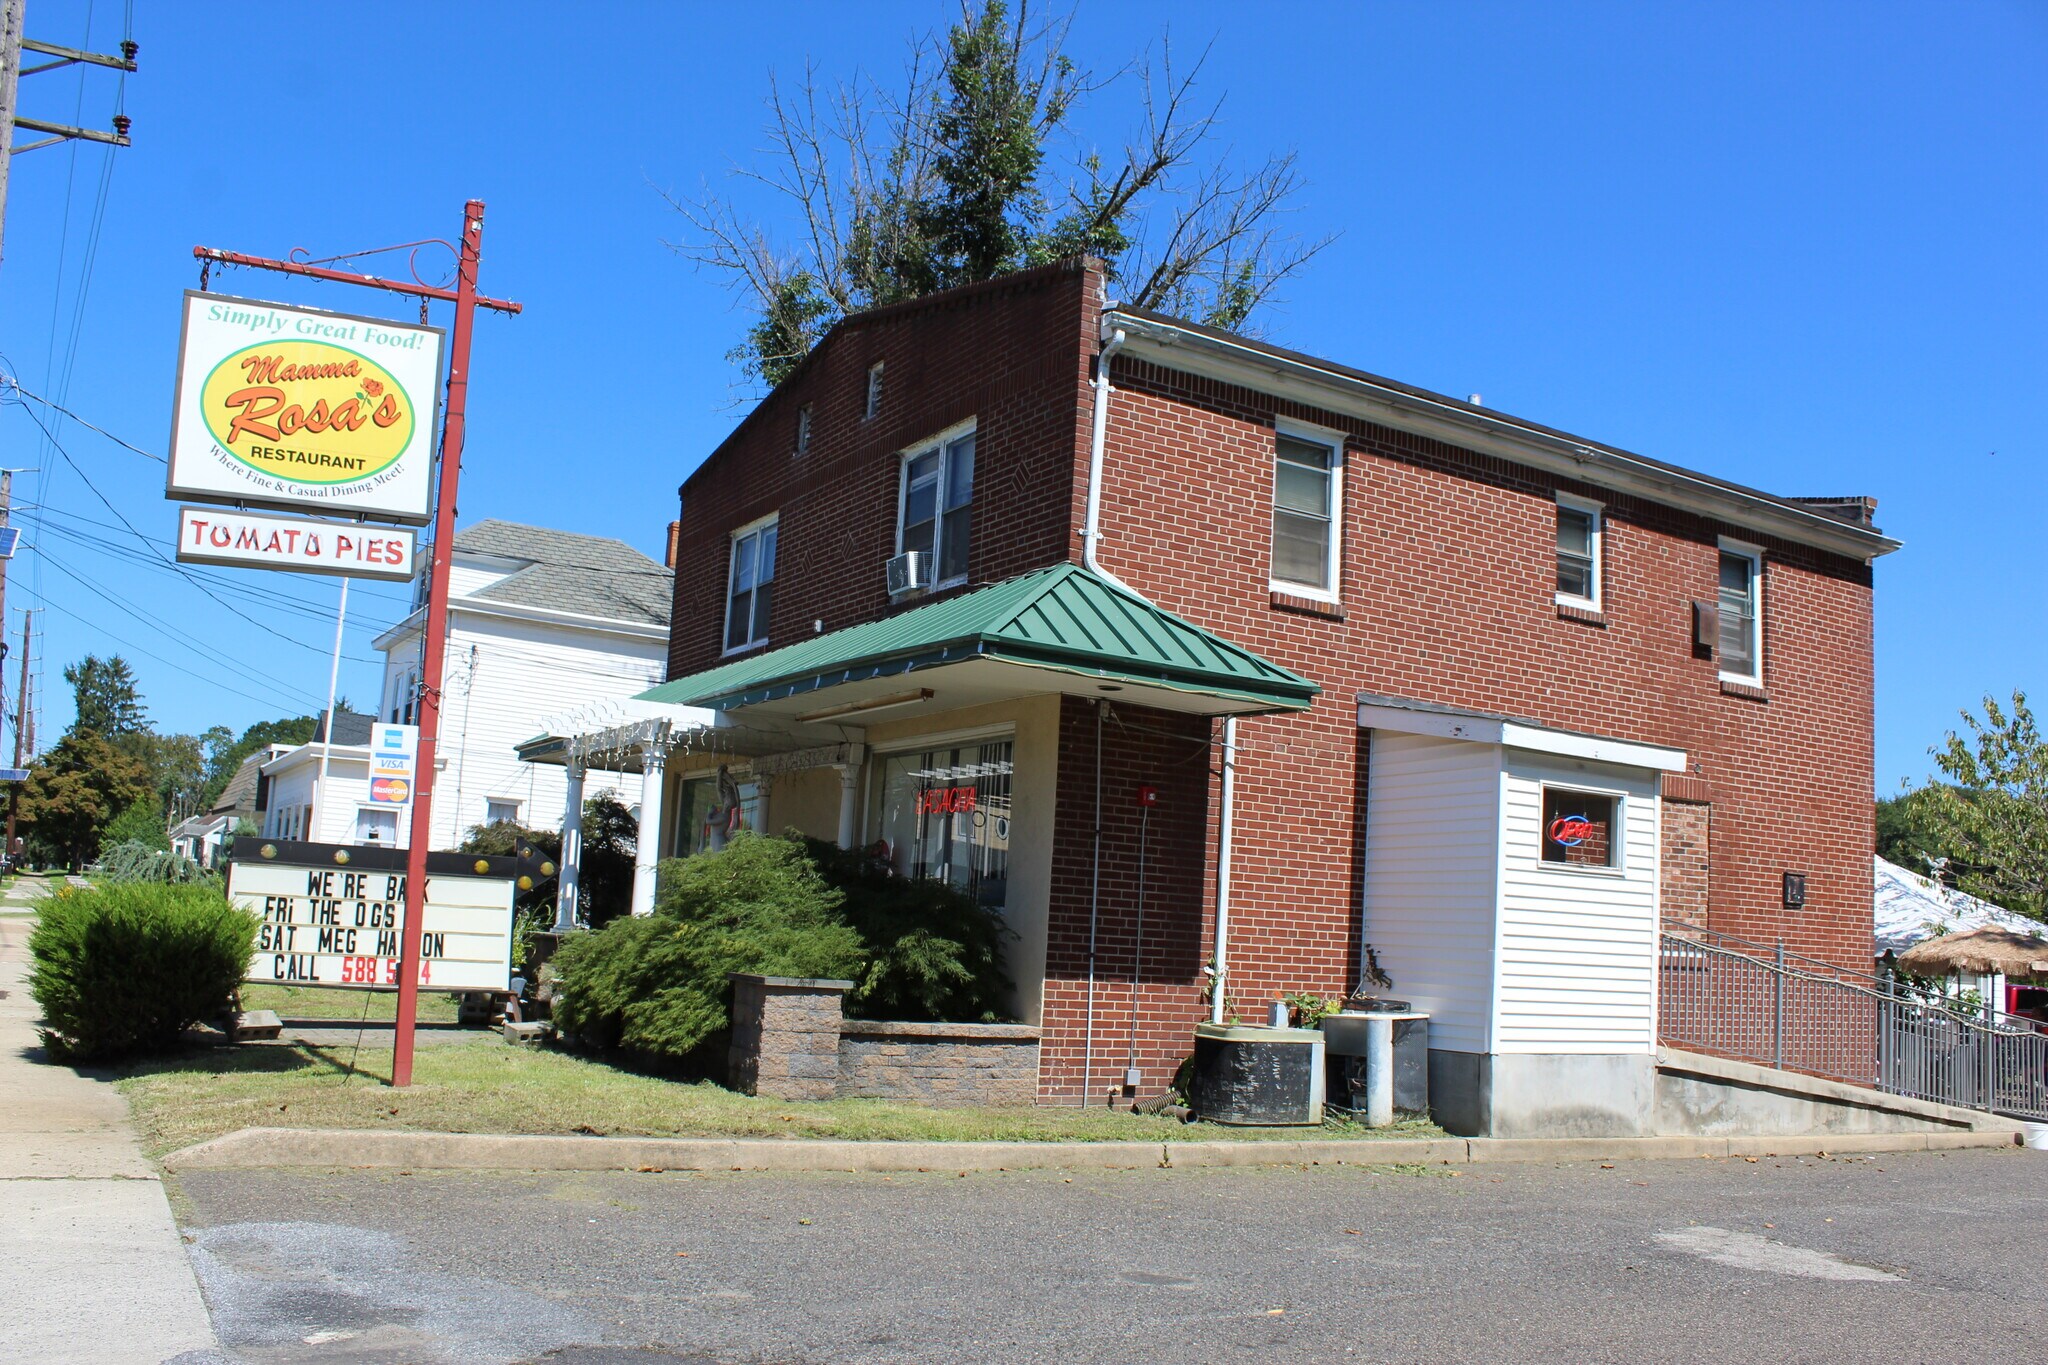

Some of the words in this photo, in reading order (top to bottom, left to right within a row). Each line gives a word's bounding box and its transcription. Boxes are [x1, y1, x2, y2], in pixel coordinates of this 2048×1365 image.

[208, 304, 288, 334] Simply
[295, 317, 357, 341] Great
[364, 328, 425, 350] Food!
[241, 355, 362, 384] Mamma
[225, 385, 401, 444] Rosa's
[209, 444, 245, 476] Where
[245, 470, 272, 488] Fine
[274, 482, 285, 492] &
[288, 484, 328, 497] Casual
[332, 483, 373, 497] Dining
[374, 463, 405, 487] Meet!
[251, 446, 366, 470] RESTAURANT
[190, 520, 321, 557] TOMATO
[335, 535, 404, 565] PIES
[381, 760, 404, 769] VISA
[373, 785, 408, 796] MasterCard
[308, 871, 368, 899] WE'RE
[386, 875, 431, 903] BAK
[310, 899, 342, 925] THE
[260, 924, 297, 951] SAT
[318, 927, 357, 953] MEG
[274, 953, 320, 980] CALL
[341, 956, 376, 983] 588
